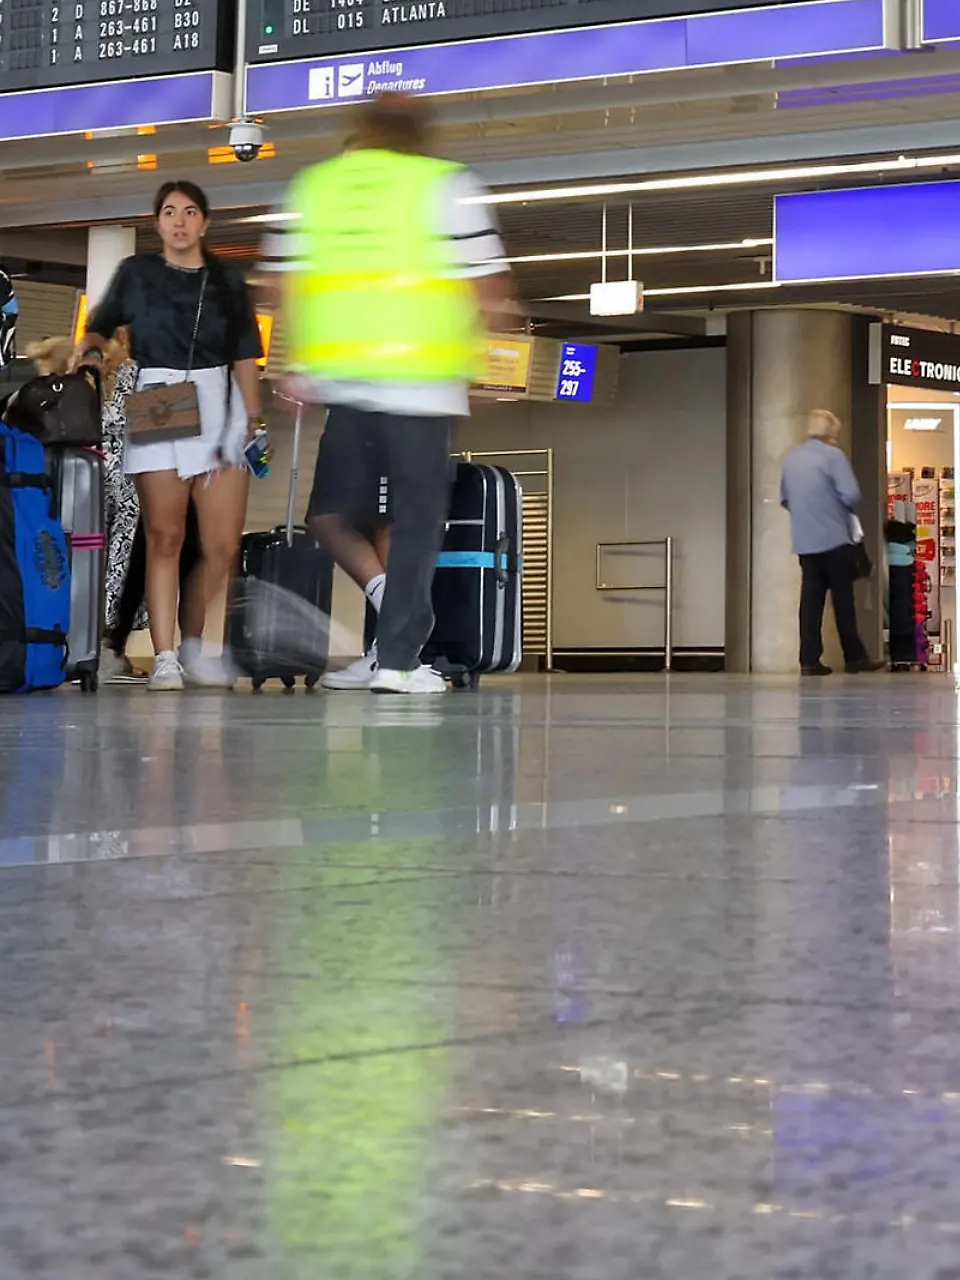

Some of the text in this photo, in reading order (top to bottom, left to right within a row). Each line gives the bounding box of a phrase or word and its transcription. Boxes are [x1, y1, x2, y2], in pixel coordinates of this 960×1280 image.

[381, 1, 446, 24] ATLANTA
[367, 60, 402, 76] Abflug
[559, 380, 579, 396] 297
